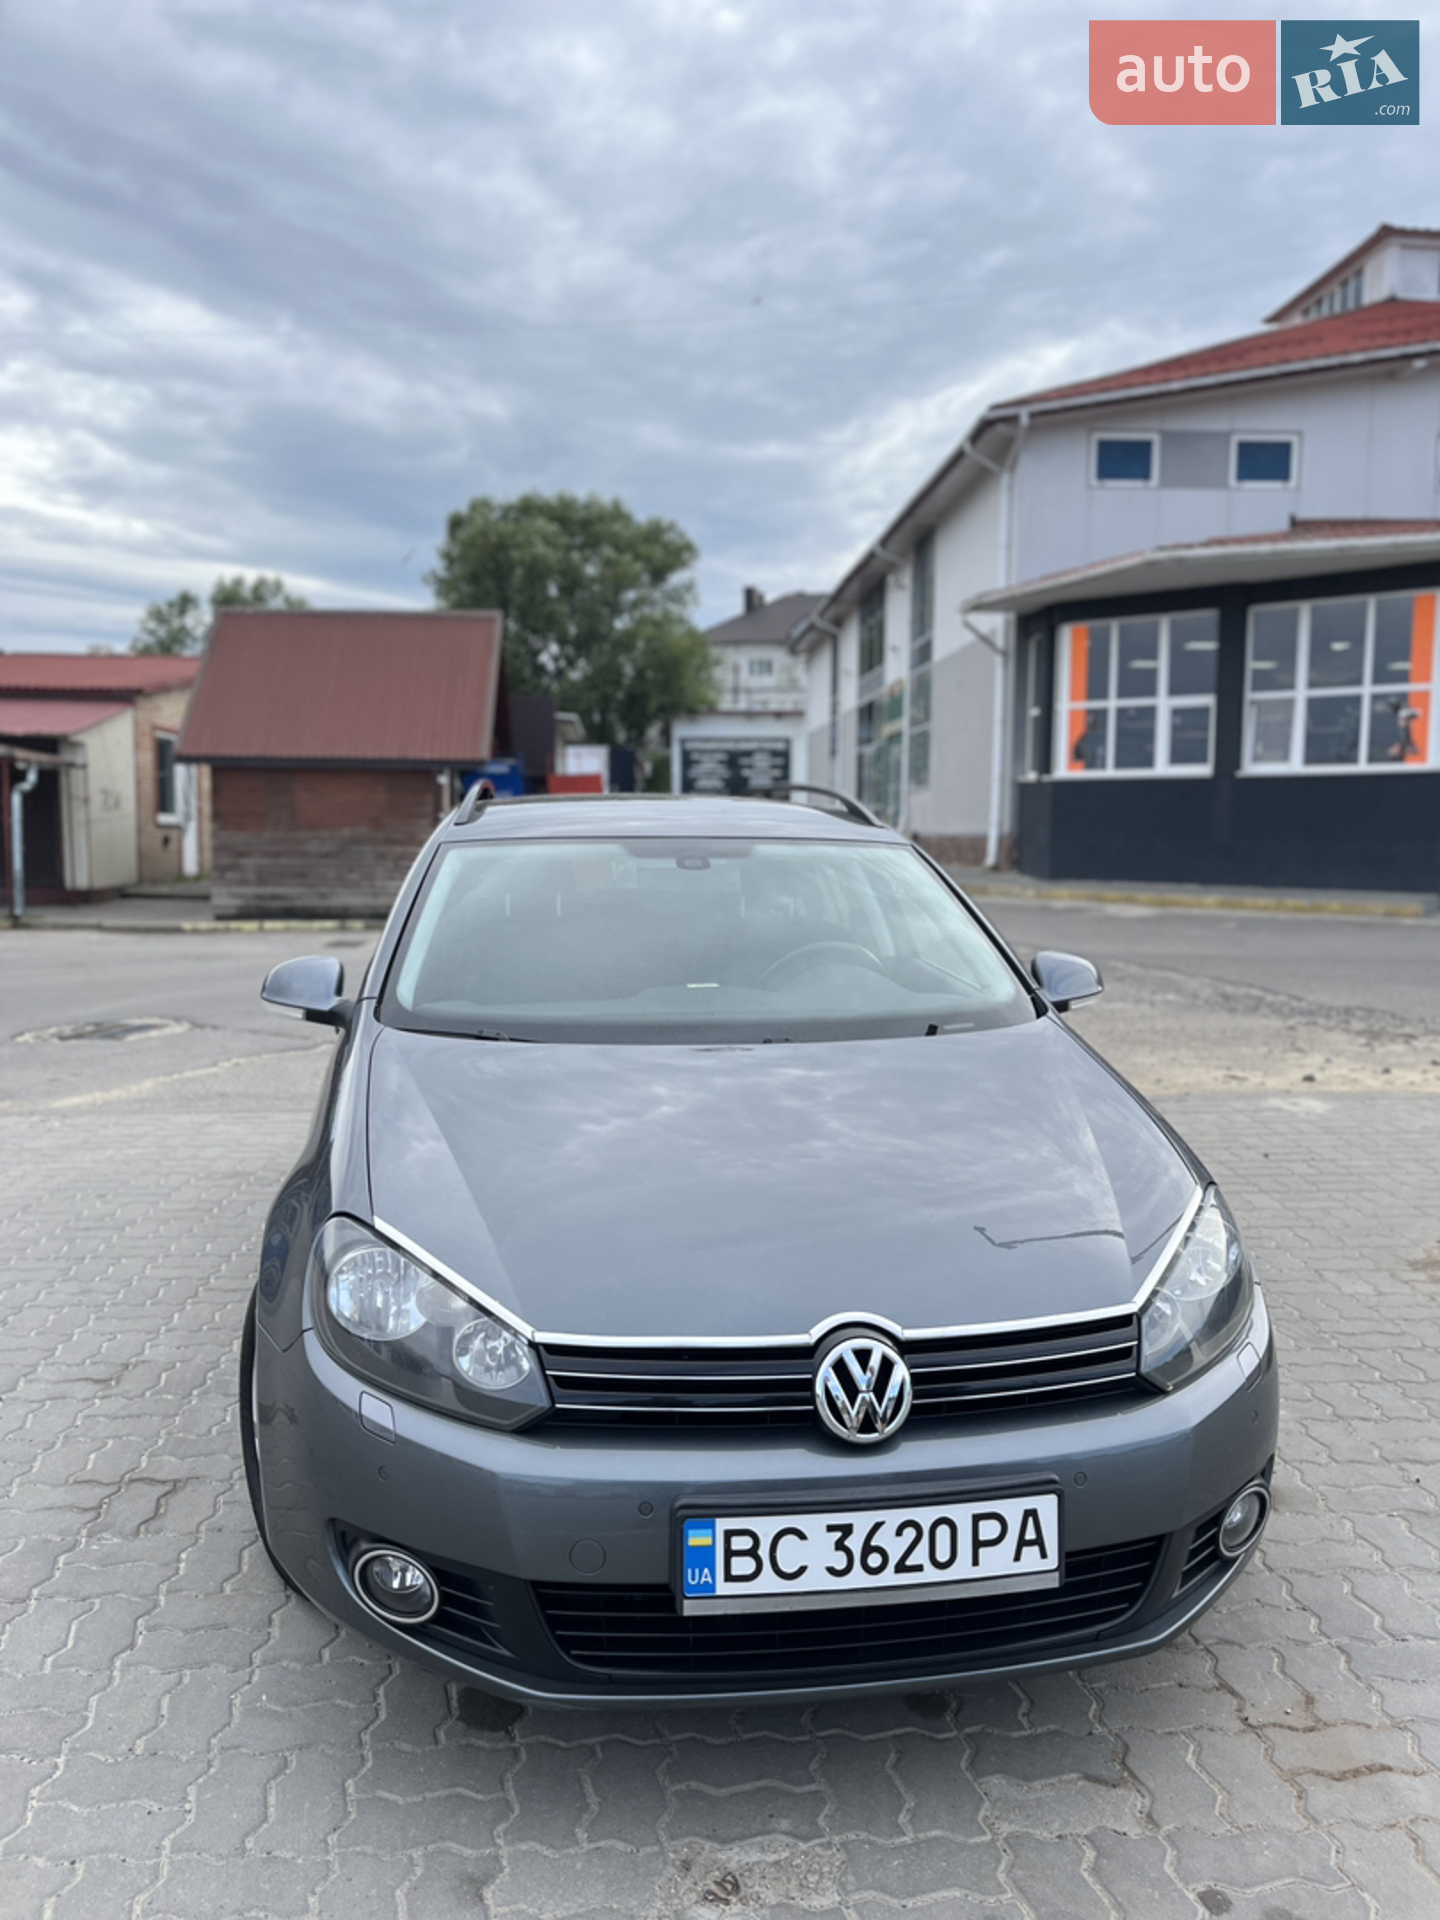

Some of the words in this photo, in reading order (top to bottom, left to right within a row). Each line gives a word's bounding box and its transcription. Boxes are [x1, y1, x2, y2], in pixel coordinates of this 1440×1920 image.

[818, 1341, 911, 1441] VW
[687, 1568, 713, 1585] UA
[723, 1526, 809, 1583] BC
[824, 1514, 958, 1578] 3620
[971, 1507, 1048, 1567] PA
